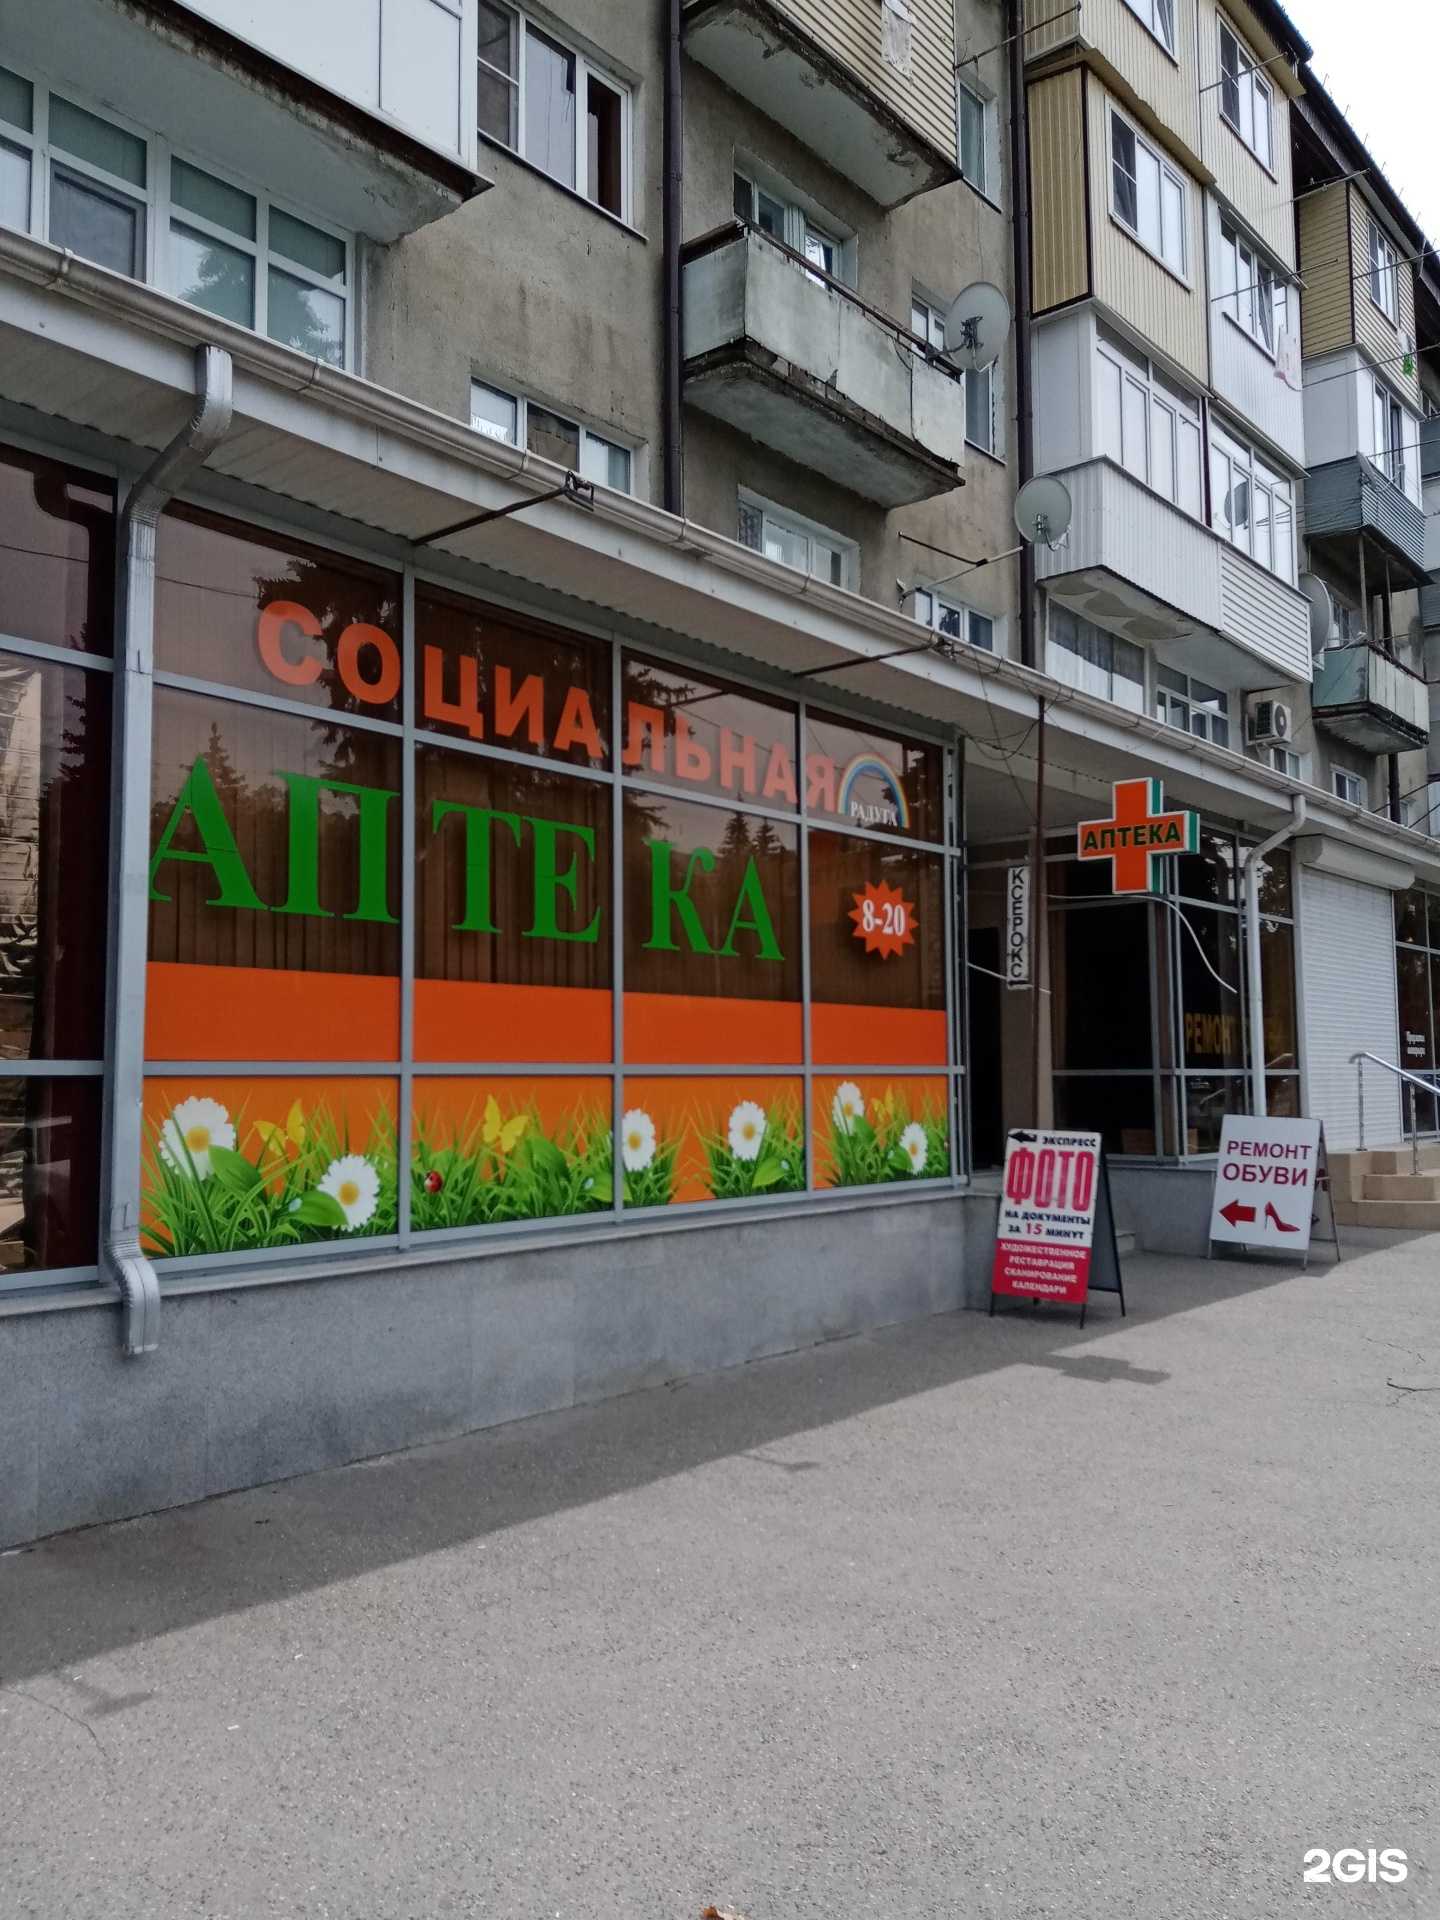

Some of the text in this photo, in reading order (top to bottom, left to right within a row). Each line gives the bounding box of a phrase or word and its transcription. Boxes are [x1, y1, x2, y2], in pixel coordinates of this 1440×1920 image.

[257, 600, 835, 813] СОЦИАЛЬНАЯ
[850, 801, 898, 827] РАДУГА
[1083, 822, 1181, 850] АПТЕКА
[149, 754, 785, 961] АПТЕКА
[862, 899, 906, 937] 8-20
[1010, 869, 1026, 978] КСЕРОКС
[1042, 1136, 1097, 1148] ЭКСПРЕСС
[1227, 1140, 1312, 1160] РЕМОНТ
[1007, 1148, 1094, 1211] ФОТО
[1223, 1163, 1308, 1187] ОБУВИ
[1005, 1210, 1091, 1225] НА ДОКУМЕНТЫ
[1008, 1223, 1084, 1239] ЗА 15 МИНУТ
[1008, 1256, 1075, 1270] РЕСТАВРАЦИЯ
[1011, 1280, 1067, 1294] КАЛЕНДАРИ
